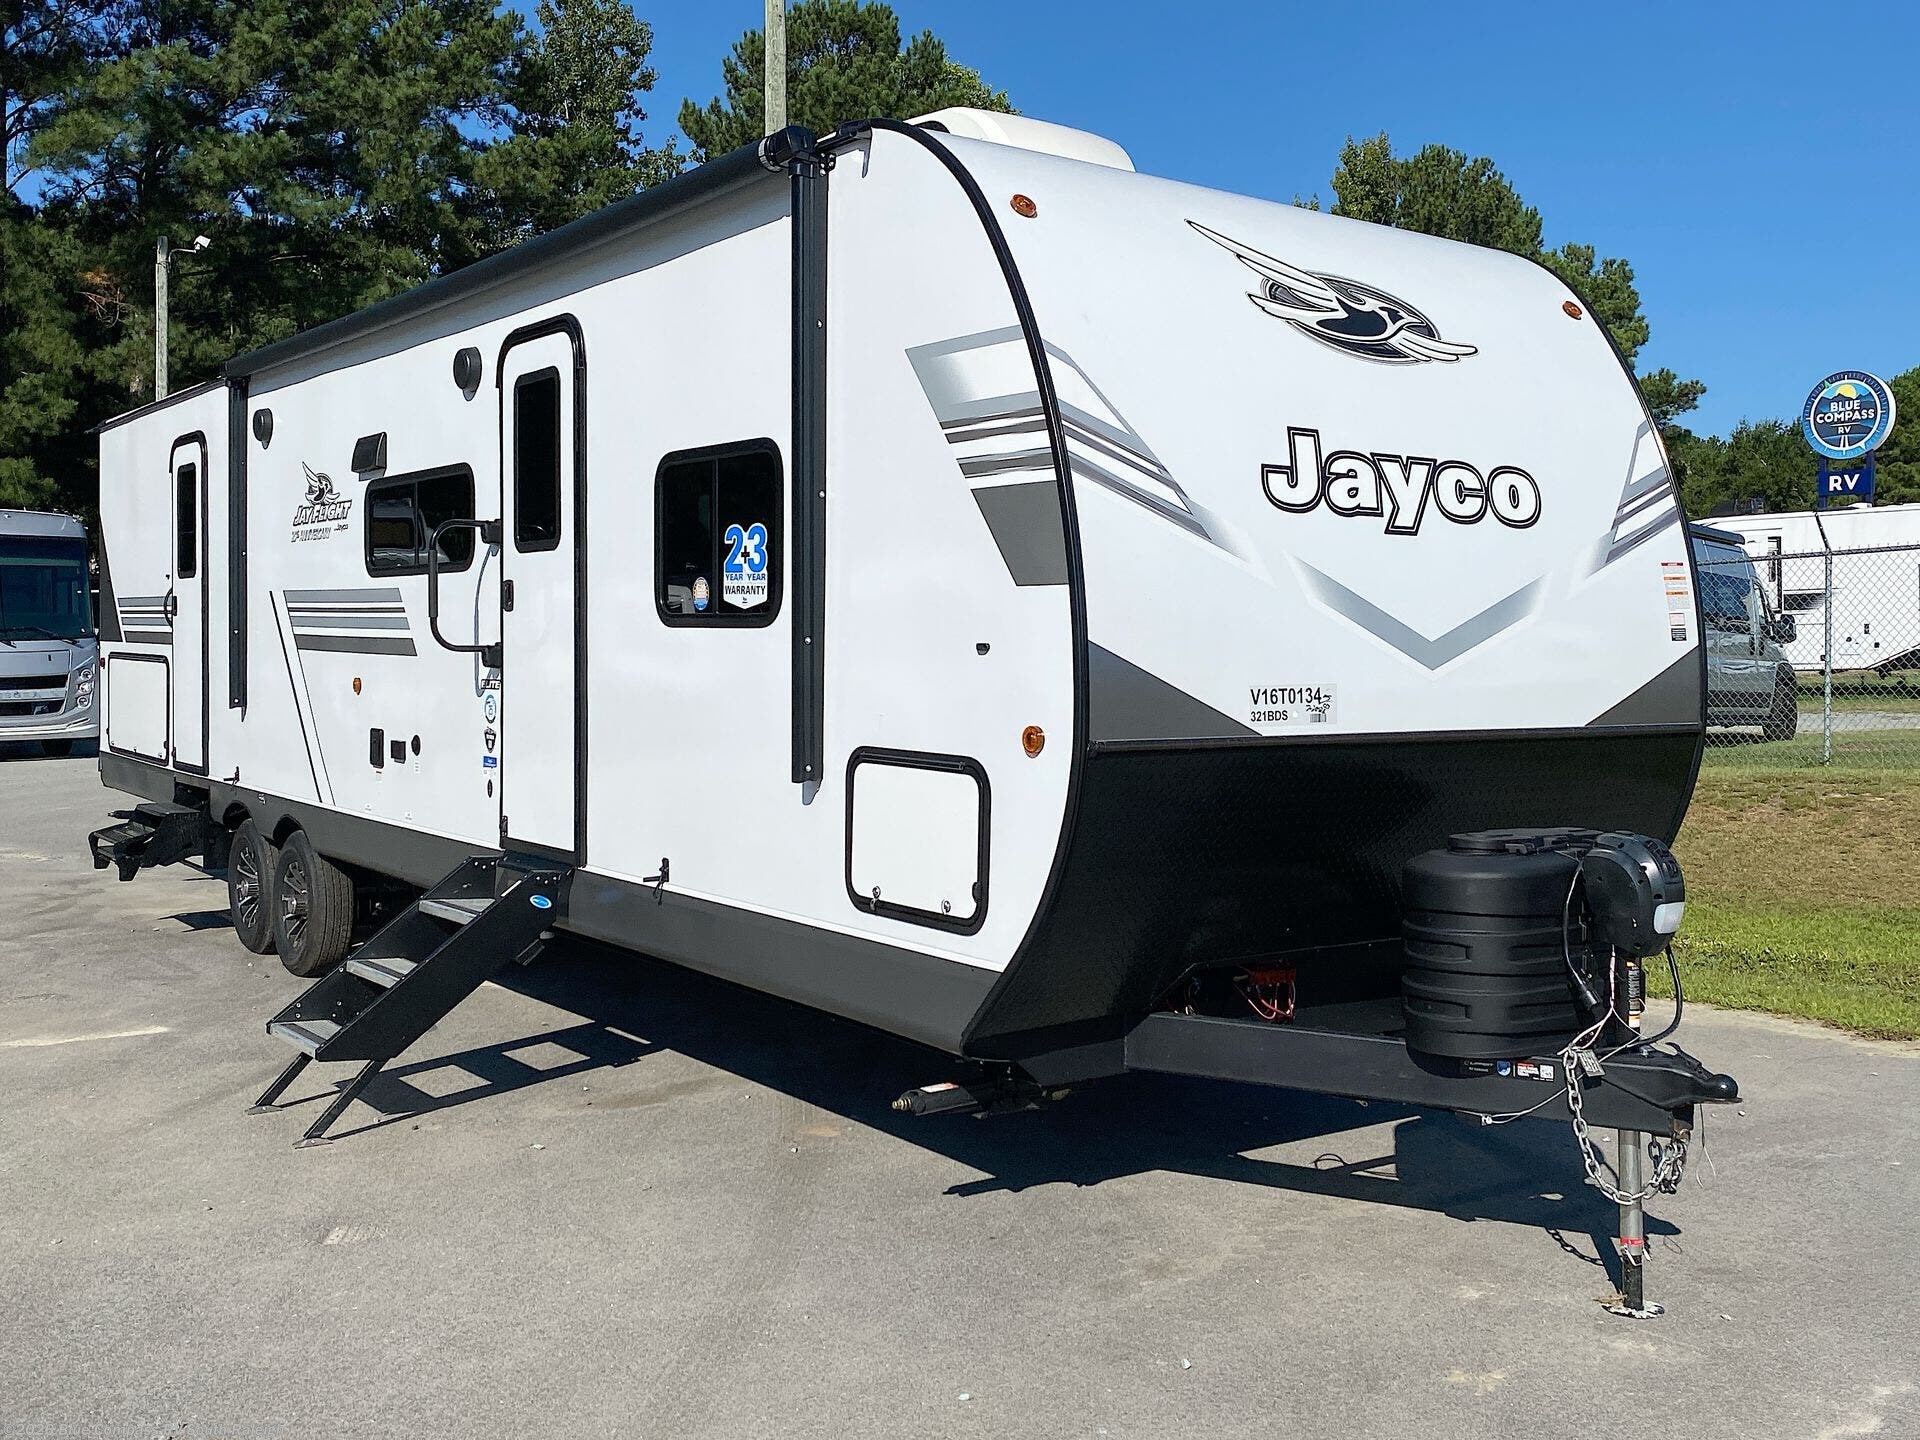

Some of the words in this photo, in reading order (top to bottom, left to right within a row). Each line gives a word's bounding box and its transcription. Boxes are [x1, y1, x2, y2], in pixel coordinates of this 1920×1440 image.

[1830, 400, 1861, 412] BLUE
[1816, 409, 1875, 424] COMPASS
[1837, 426, 1852, 434] RV
[1261, 426, 1542, 536] Jayco
[1828, 473, 1860, 492] RV
[725, 573, 744, 581] YEAR
[747, 573, 767, 581] YEAR
[724, 585, 766, 595] WARRANTY
[1250, 687, 1322, 705] V16T0134
[1250, 710, 1289, 722] 321BDS
